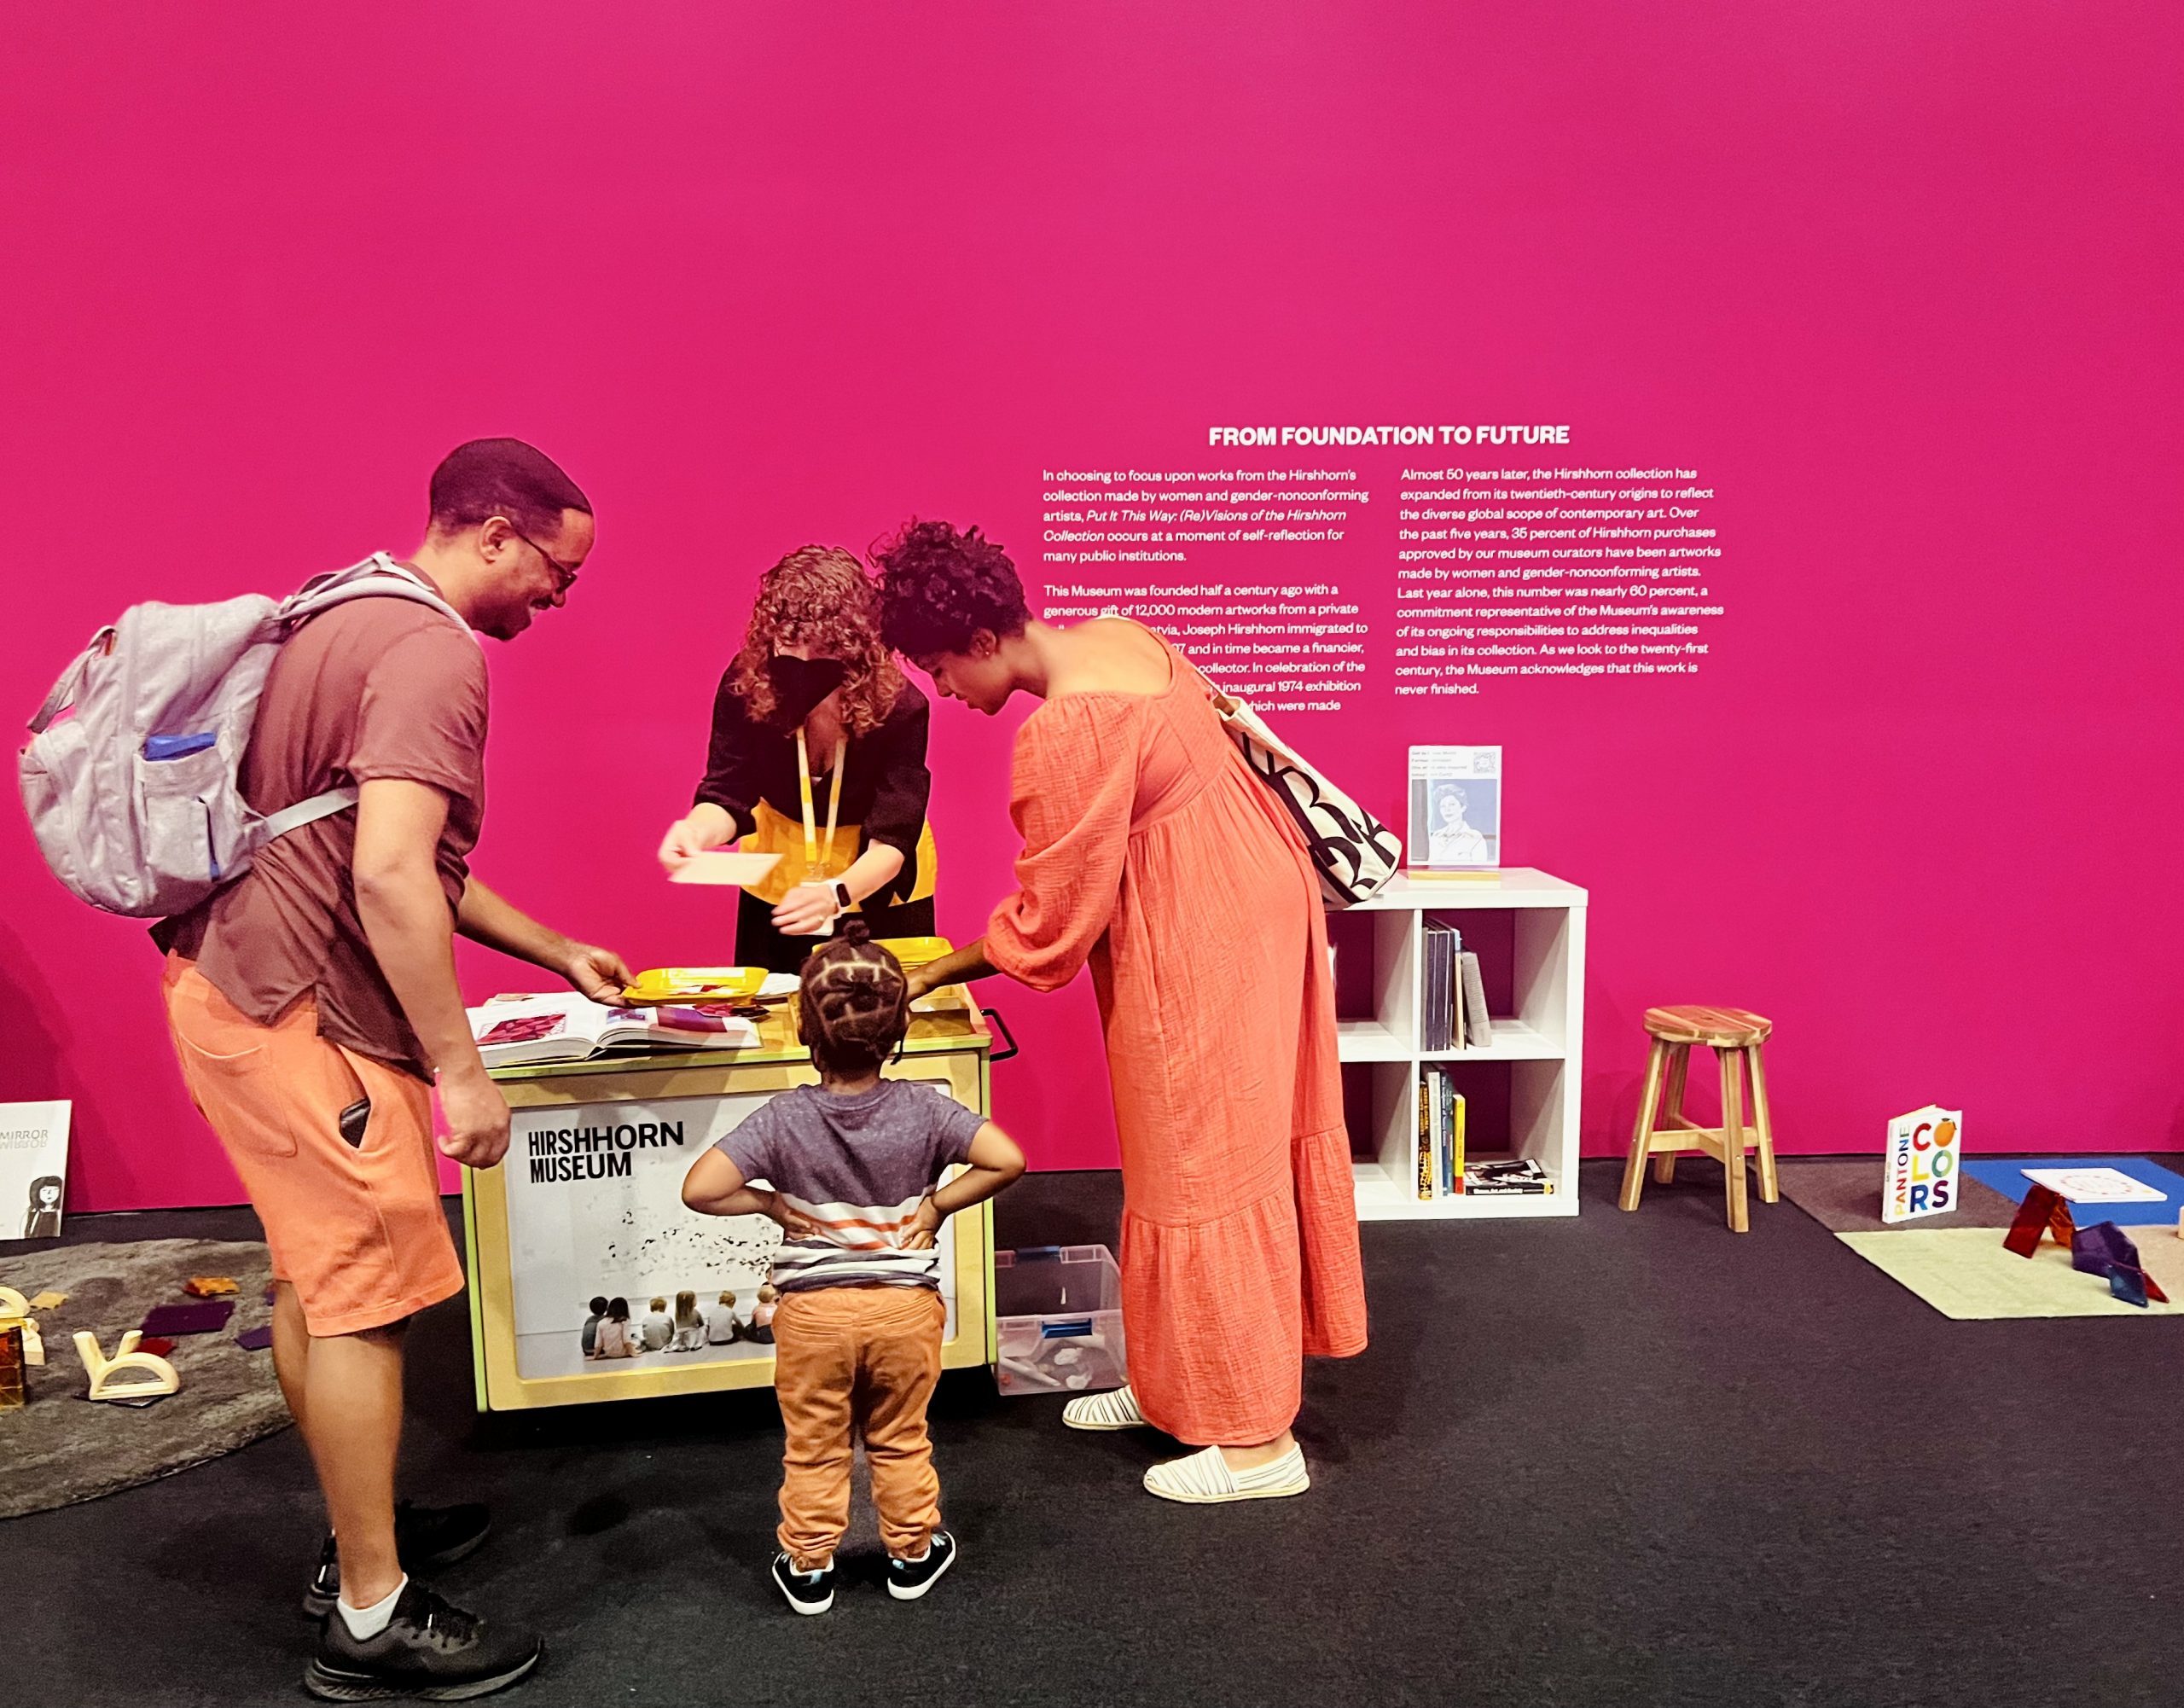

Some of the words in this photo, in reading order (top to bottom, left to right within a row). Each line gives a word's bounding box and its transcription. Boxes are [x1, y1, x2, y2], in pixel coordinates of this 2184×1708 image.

[1209, 427, 1277, 445] FROM
[1281, 426, 1434, 445] FOUNDATION
[1438, 426, 1472, 444] TO
[1476, 426, 1571, 444] FUTURE
[1043, 470, 1054, 480] In
[1056, 470, 1112, 484] choosing
[1113, 472, 1127, 481] to
[1128, 470, 1163, 481] focus
[1165, 473, 1195, 483] upon
[1197, 470, 1234, 481] works
[1235, 470, 1265, 481] from
[1267, 470, 1287, 480] the
[1289, 469, 1356, 480] Hirshhorn's
[1400, 469, 1444, 479] Almost
[1446, 468, 1464, 479] 50
[1465, 471, 1499, 482] years
[1501, 468, 1531, 480] later,
[1532, 468, 1553, 479] the
[1554, 468, 1613, 479] Hirshhorn
[1615, 468, 1674, 479] collection
[1676, 468, 1698, 479] has
[1043, 490, 1102, 502] collection
[1104, 491, 1139, 501] made
[1141, 491, 1157, 503] by
[1159, 492, 1203, 501] women
[1205, 490, 1228, 501] and
[1229, 489, 1369, 503] gender-nonconforming
[1400, 489, 1461, 502] expanded
[1462, 488, 1491, 499] from
[1493, 489, 1508, 499] its
[1510, 488, 1617, 501] twentieth-century
[1618, 488, 1658, 501] origins
[1660, 489, 1674, 498] to
[1675, 487, 1714, 498] reflect
[1043, 510, 1084, 522] artists,
[1086, 510, 1107, 521] Put
[1109, 510, 1118, 521] It
[1121, 510, 1147, 521] This
[1149, 510, 1178, 523] Way:
[1179, 509, 1248, 522] (Re)Visions
[1250, 509, 1265, 521] of
[1264, 509, 1285, 521] the
[1287, 509, 1347, 520] Hirshhorn
[1399, 509, 1420, 520] the
[1421, 508, 1466, 520] diverse
[1467, 508, 1504, 521] global
[1506, 510, 1543, 521] scope
[1544, 508, 1560, 519] of
[1559, 509, 1645, 520] contemporary
[1647, 508, 1667, 518] art.
[1669, 507, 1700, 518] Over
[1043, 530, 1105, 541] Collection
[1150, 532, 1164, 541] at
[1165, 532, 1173, 541] a
[1175, 532, 1226, 541] moment
[1228, 530, 1242, 541] of
[1242, 529, 1325, 540] self-reflection
[1327, 529, 1345, 540] for
[1398, 529, 1420, 539] the
[1420, 530, 1448, 541] past
[1449, 528, 1472, 539] five
[1473, 531, 1509, 541] years,
[1511, 527, 1528, 538] 35
[1529, 529, 1577, 541] percent
[1577, 527, 1593, 538] of
[1593, 527, 1652, 537] Hirshhorn
[1653, 526, 1716, 540] purchases
[1043, 553, 1077, 563] many
[1079, 550, 1117, 563] public
[1118, 550, 1187, 561] institutions.
[1398, 548, 1456, 561] approved
[1458, 548, 1473, 561] by
[1475, 550, 1496, 559] our
[1552, 549, 1603, 558] curators
[1605, 547, 1635, 557] have
[1636, 547, 1667, 557] been
[1668, 546, 1722, 557] artworks
[1397, 567, 1432, 578] made
[1434, 568, 1450, 580] by
[1451, 570, 1496, 578] women
[1497, 567, 1521, 578] and
[1522, 566, 1660, 580] gender-nonconforming
[1661, 566, 1701, 577] artists.
[1043, 585, 1070, 596] This
[1071, 585, 1123, 596] Museum
[1149, 585, 1199, 595] founded
[1200, 584, 1223, 595] half
[1223, 587, 1232, 595] a
[1233, 586, 1279, 597] century
[1280, 587, 1303, 597] ago
[1304, 584, 1329, 595] with
[1330, 586, 1339, 595] a
[1397, 588, 1424, 598] Last
[1426, 590, 1453, 600] year
[1455, 587, 1490, 598] alone,
[1492, 587, 1514, 597] this
[1516, 586, 1563, 597] number
[1590, 586, 1628, 598] nearly
[1629, 585, 1647, 596] 60
[1648, 587, 1699, 598] percent,
[1043, 607, 1099, 619] generous
[1121, 604, 1135, 616] of
[1135, 604, 1176, 617] 12,000
[1177, 605, 1223, 615] modern
[1224, 604, 1277, 615] artworks
[1278, 603, 1307, 614] from
[1308, 606, 1316, 614] a
[1317, 603, 1359, 616] private
[1396, 607, 1473, 618] commitment
[1475, 606, 1562, 619] representative
[1563, 605, 1577, 616] of
[1577, 606, 1598, 616] the
[1600, 605, 1658, 615] Museum's
[1660, 607, 1724, 615] awareness
[1182, 624, 1226, 636] Joseph
[1228, 624, 1286, 634] Hirshhorn
[1287, 623, 1354, 636] immigrated
[1356, 624, 1368, 633] to
[1188, 643, 1211, 654] and
[1212, 643, 1223, 654] in
[1224, 643, 1252, 654] time
[1252, 643, 1301, 654] became
[1311, 642, 1364, 654] financier,
[1198, 662, 1251, 673] collector.
[1252, 662, 1263, 672] In
[1264, 662, 1331, 672] celebration
[1332, 661, 1346, 671] of
[1346, 661, 1366, 671] the
[1223, 682, 1276, 694] inaugural
[1277, 681, 1304, 692] 1974
[1304, 681, 1362, 691] exhibition
[1430, 683, 1479, 694] finished.
[1307, 700, 1342, 710] made
[528, 1121, 683, 1156] HIRSHHORN
[530, 1152, 631, 1183] MUSEUM
[1895, 1124, 1910, 1216] PANTONE
